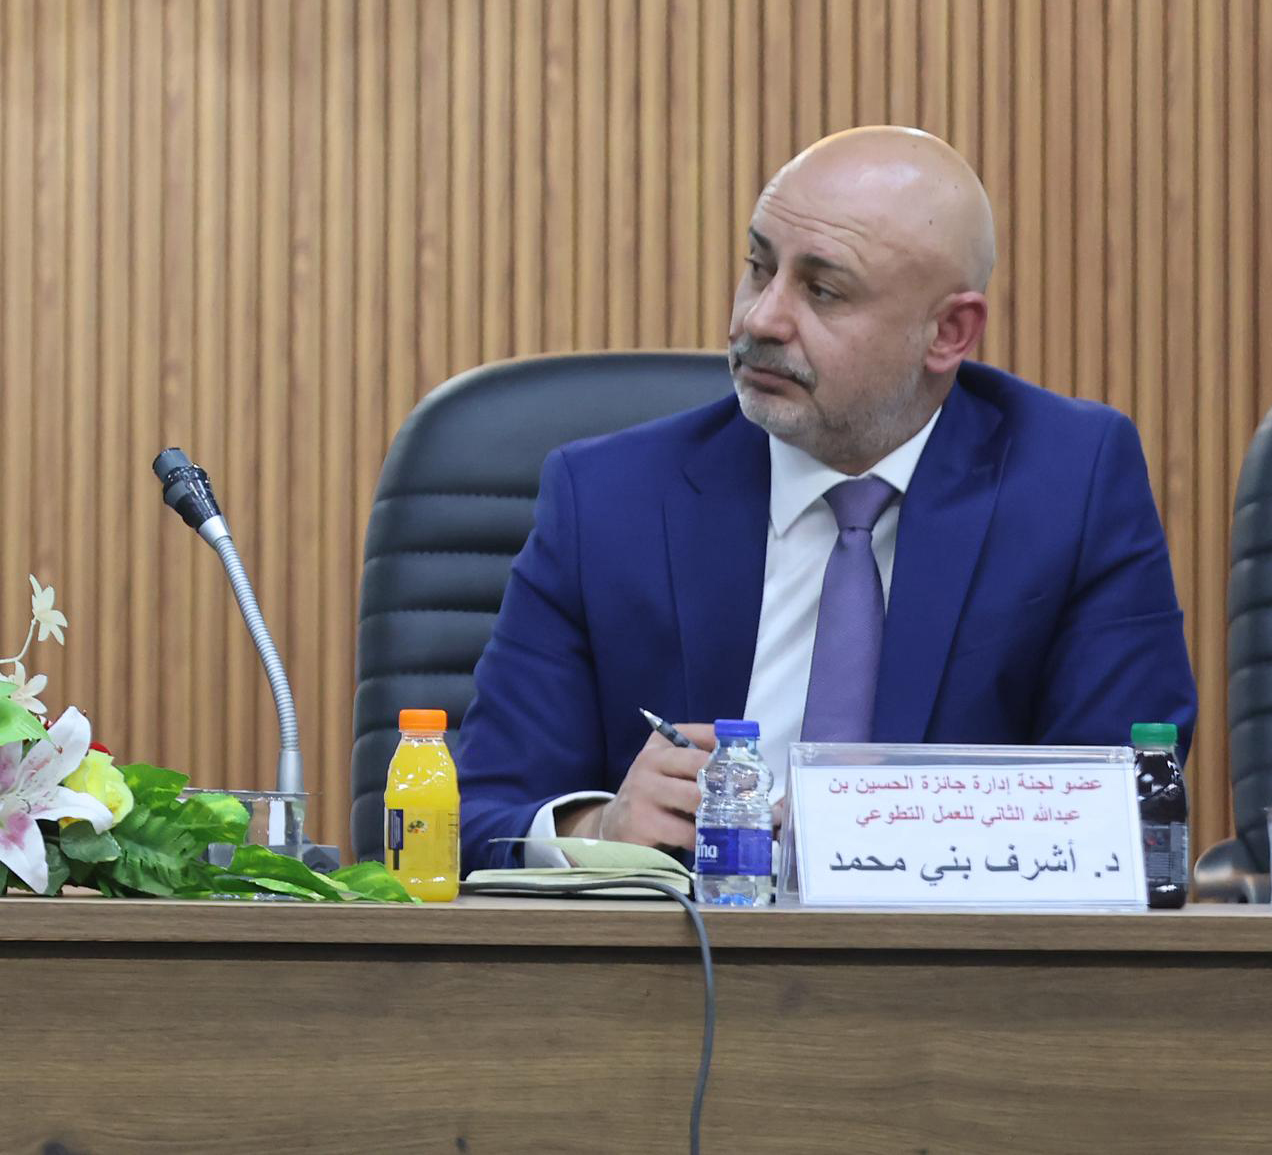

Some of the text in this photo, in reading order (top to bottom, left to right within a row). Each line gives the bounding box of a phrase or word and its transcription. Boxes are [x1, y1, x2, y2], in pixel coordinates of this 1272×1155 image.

[828, 772, 1103, 795] عضو لجنة إدارة جائزة الحسين بن
[855, 804, 925, 827] التطوعي
[931, 804, 975, 824] للعمل
[980, 803, 1025, 827] الثاني
[828, 850, 906, 872] محمد
[919, 844, 972, 887] بني
[984, 838, 1077, 881] أشرف
